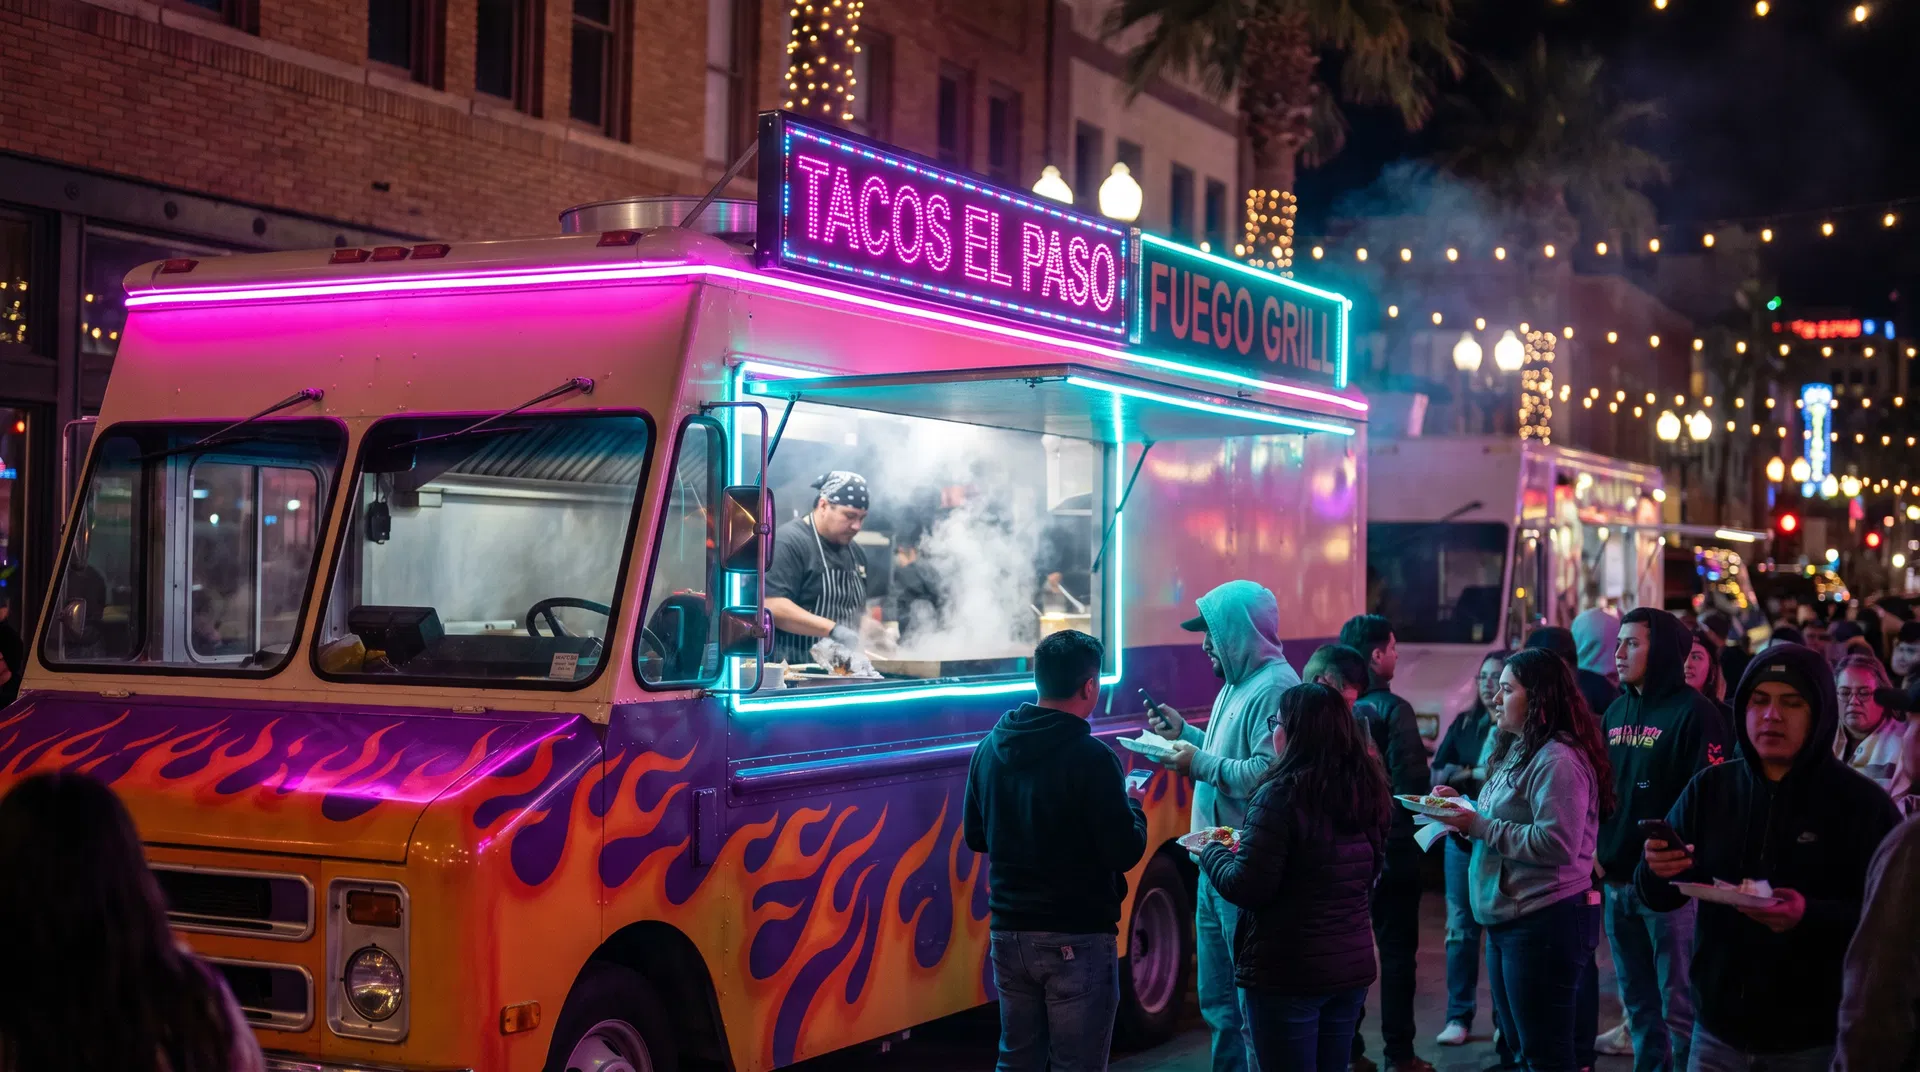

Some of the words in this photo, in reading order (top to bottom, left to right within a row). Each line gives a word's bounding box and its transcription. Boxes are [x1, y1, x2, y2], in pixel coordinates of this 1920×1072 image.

[798, 155, 951, 272] TACOS
[964, 205, 1012, 288] EL
[1023, 223, 1115, 311] PASO
[1150, 262, 1255, 355] FUEGO
[1262, 296, 1334, 374] GRILL
